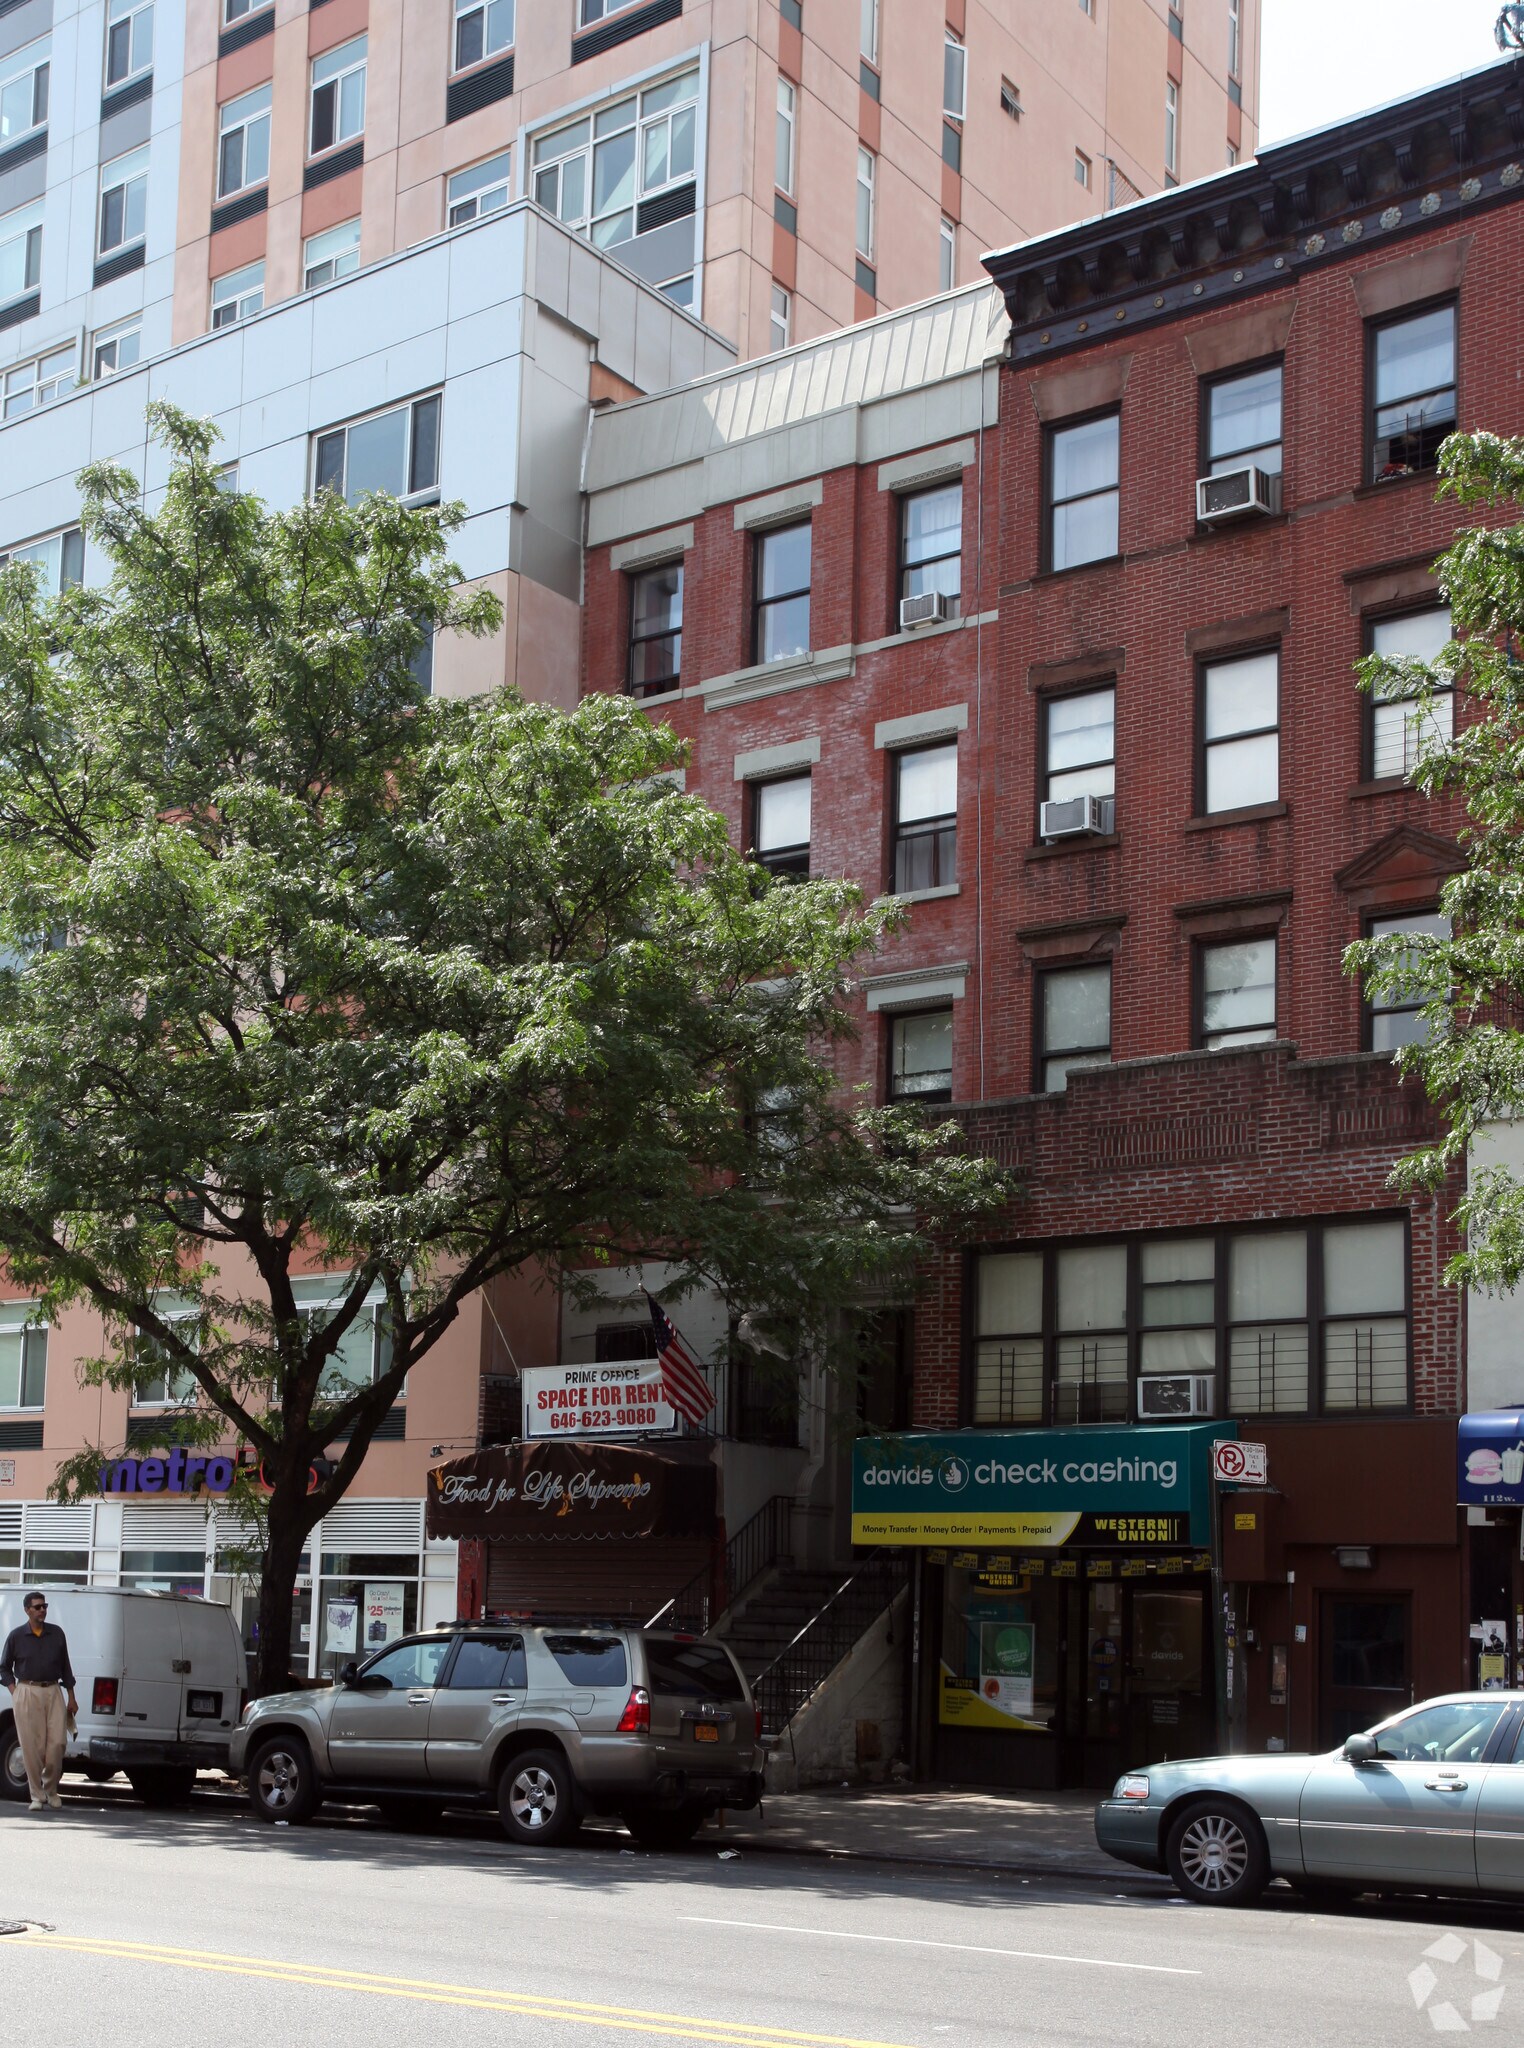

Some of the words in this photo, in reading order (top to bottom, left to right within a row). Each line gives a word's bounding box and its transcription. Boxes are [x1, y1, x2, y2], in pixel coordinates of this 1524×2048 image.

[565, 1370, 597, 1384] PRIME
[601, 1369, 640, 1382] OFFICE
[537, 1387, 587, 1410] SPACE
[592, 1385, 621, 1406] FOR
[551, 1408, 656, 1429] 646-623-9080
[863, 1465, 933, 1485] davids
[974, 1459, 1057, 1484] check
[1062, 1456, 1177, 1488] cashing
[439, 1476, 494, 1504] Food
[485, 1478, 516, 1512] for
[521, 1470, 564, 1510] Life
[568, 1469, 650, 1509] Supreme
[862, 1525, 887, 1534] Money
[889, 1525, 918, 1534] Transfer
[924, 1526, 949, 1534] Money
[951, 1526, 972, 1534] Order
[978, 1526, 1016, 1535] Payments
[1022, 1526, 1052, 1536] Prepaid
[1094, 1518, 1168, 1530] WESTERN
[1118, 1530, 1168, 1541] UNION
[367, 1605, 383, 1616] $25
[1152, 1651, 1184, 1660] davids
